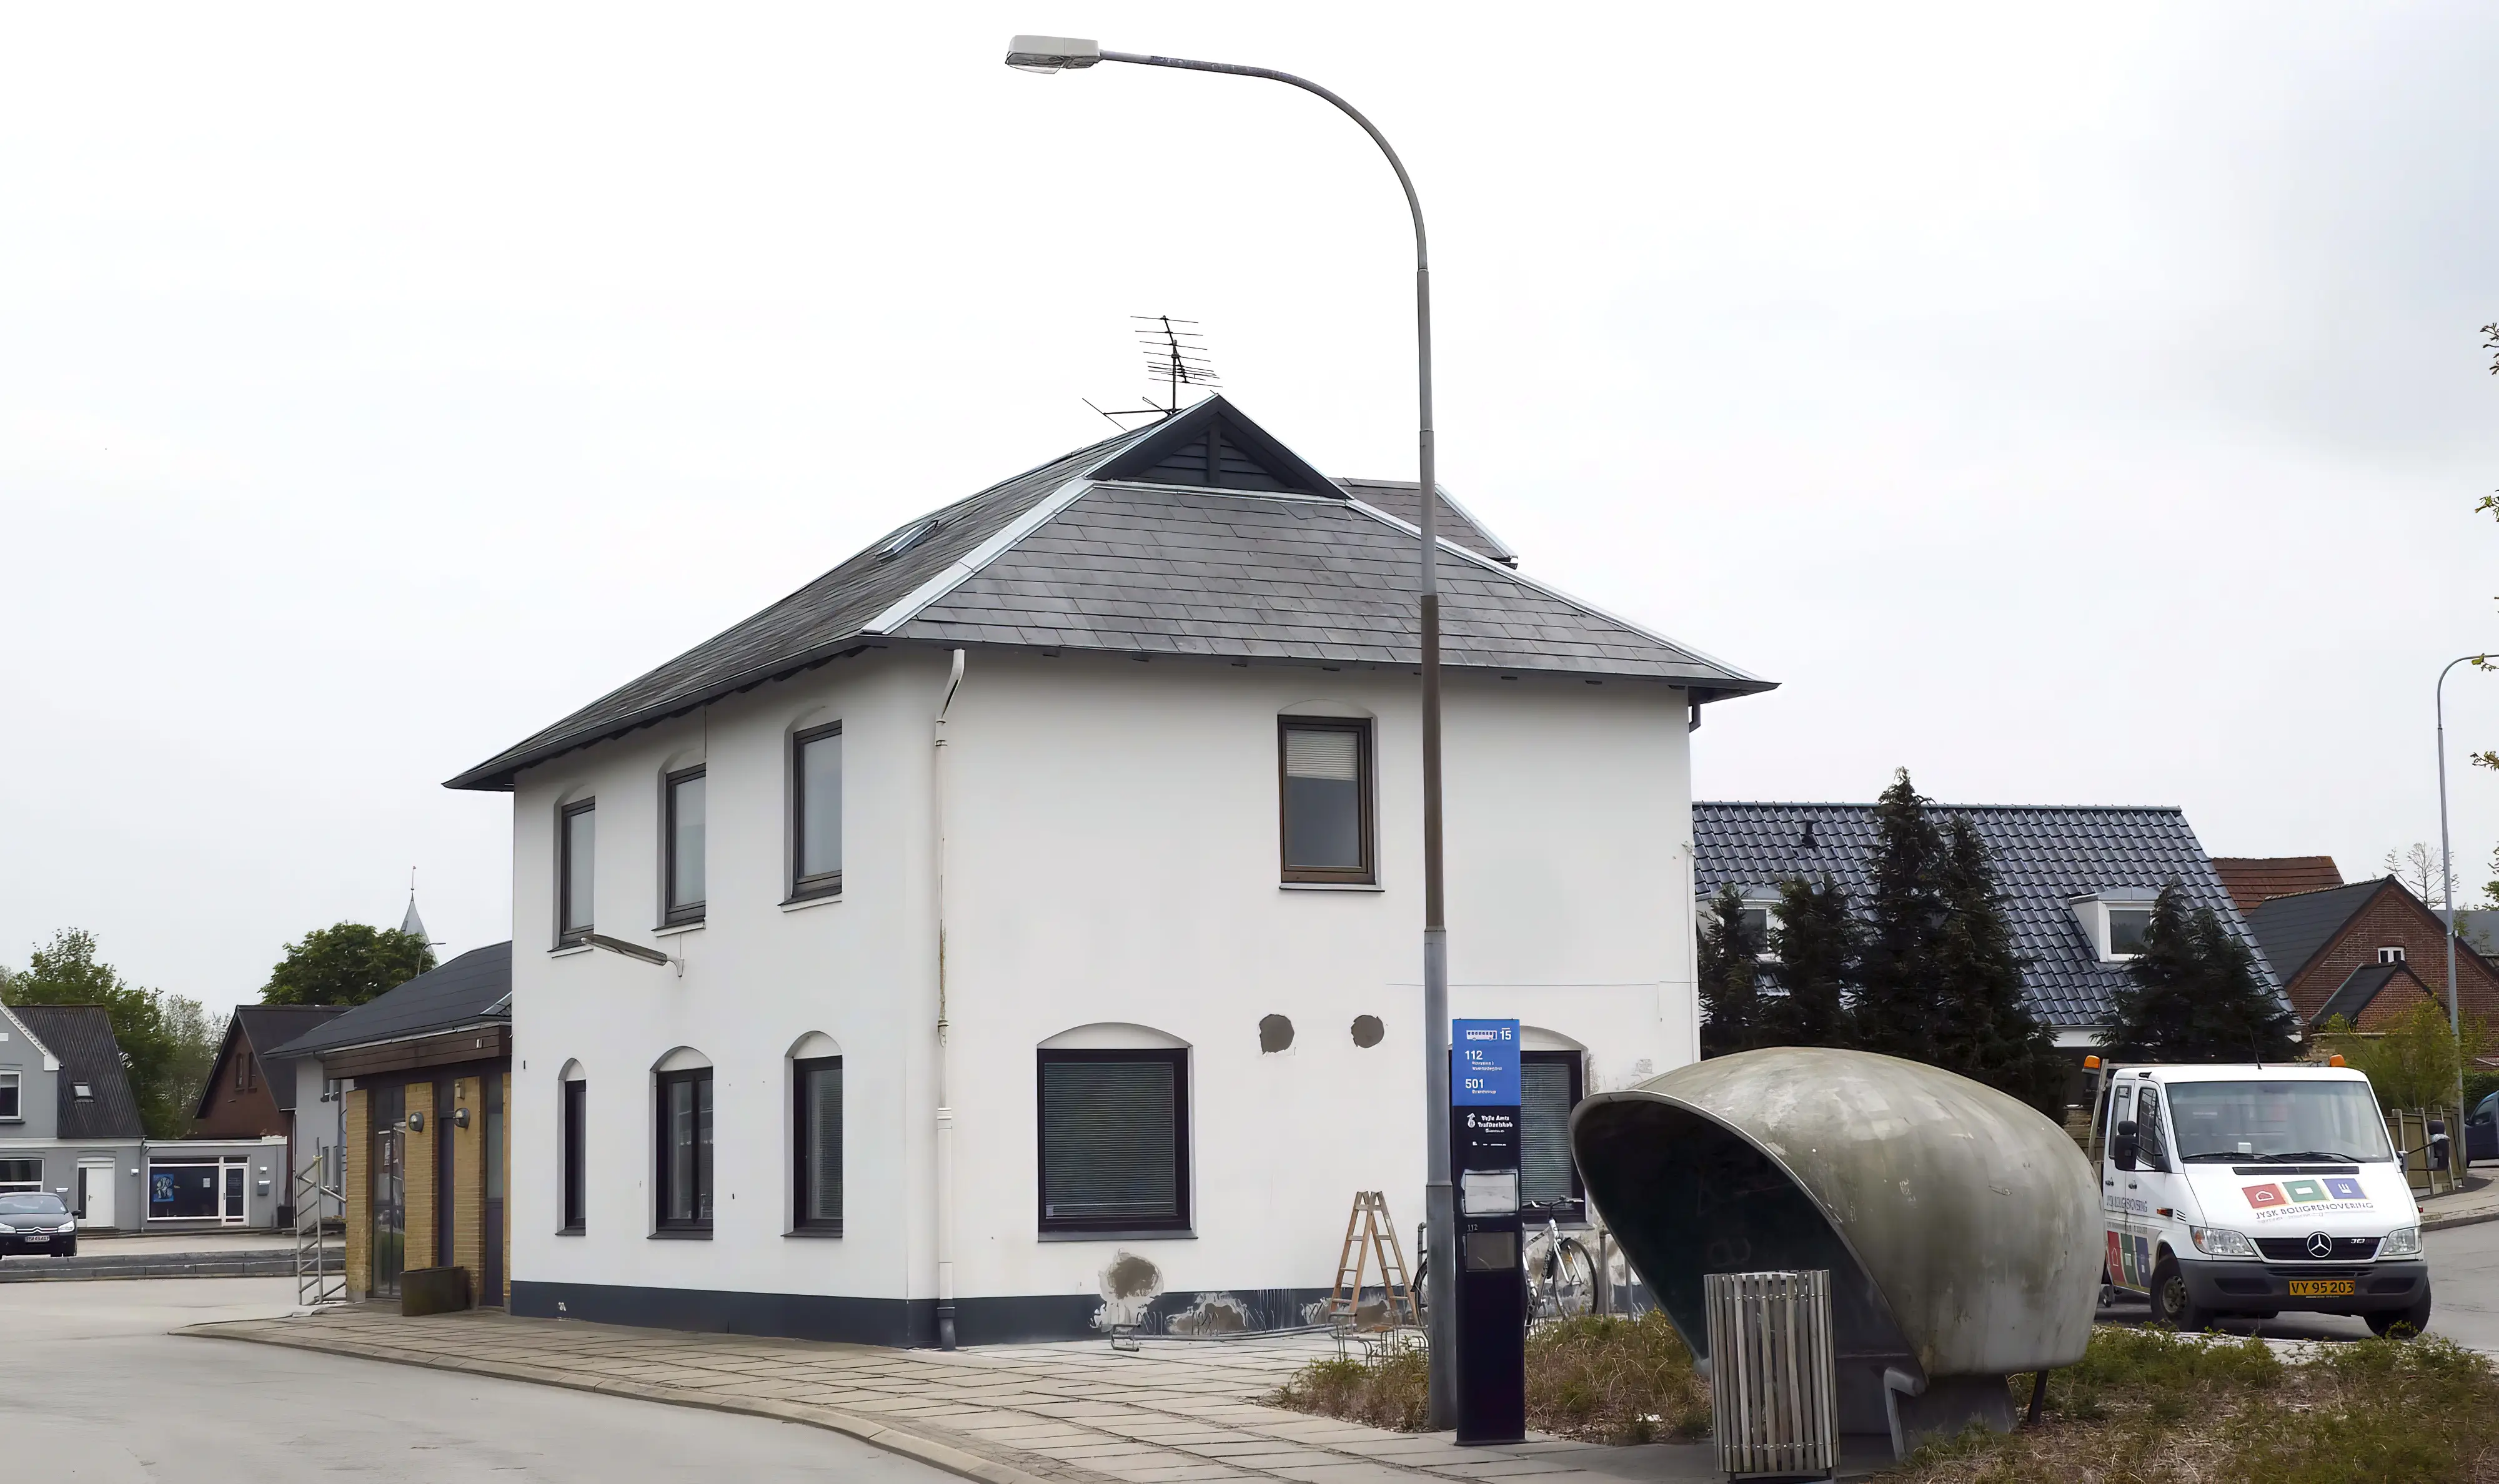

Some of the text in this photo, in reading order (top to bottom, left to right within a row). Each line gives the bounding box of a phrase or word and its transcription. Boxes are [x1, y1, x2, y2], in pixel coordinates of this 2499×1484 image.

[1499, 1030, 1511, 1041] 15
[1464, 1050, 1483, 1060] 112
[1465, 1079, 1484, 1089] 501
[2256, 1210, 2278, 1219] JYSK
[2281, 1202, 2374, 1215] BOLIGRENOVERING
[2291, 1282, 2355, 1294] VY 95 203
